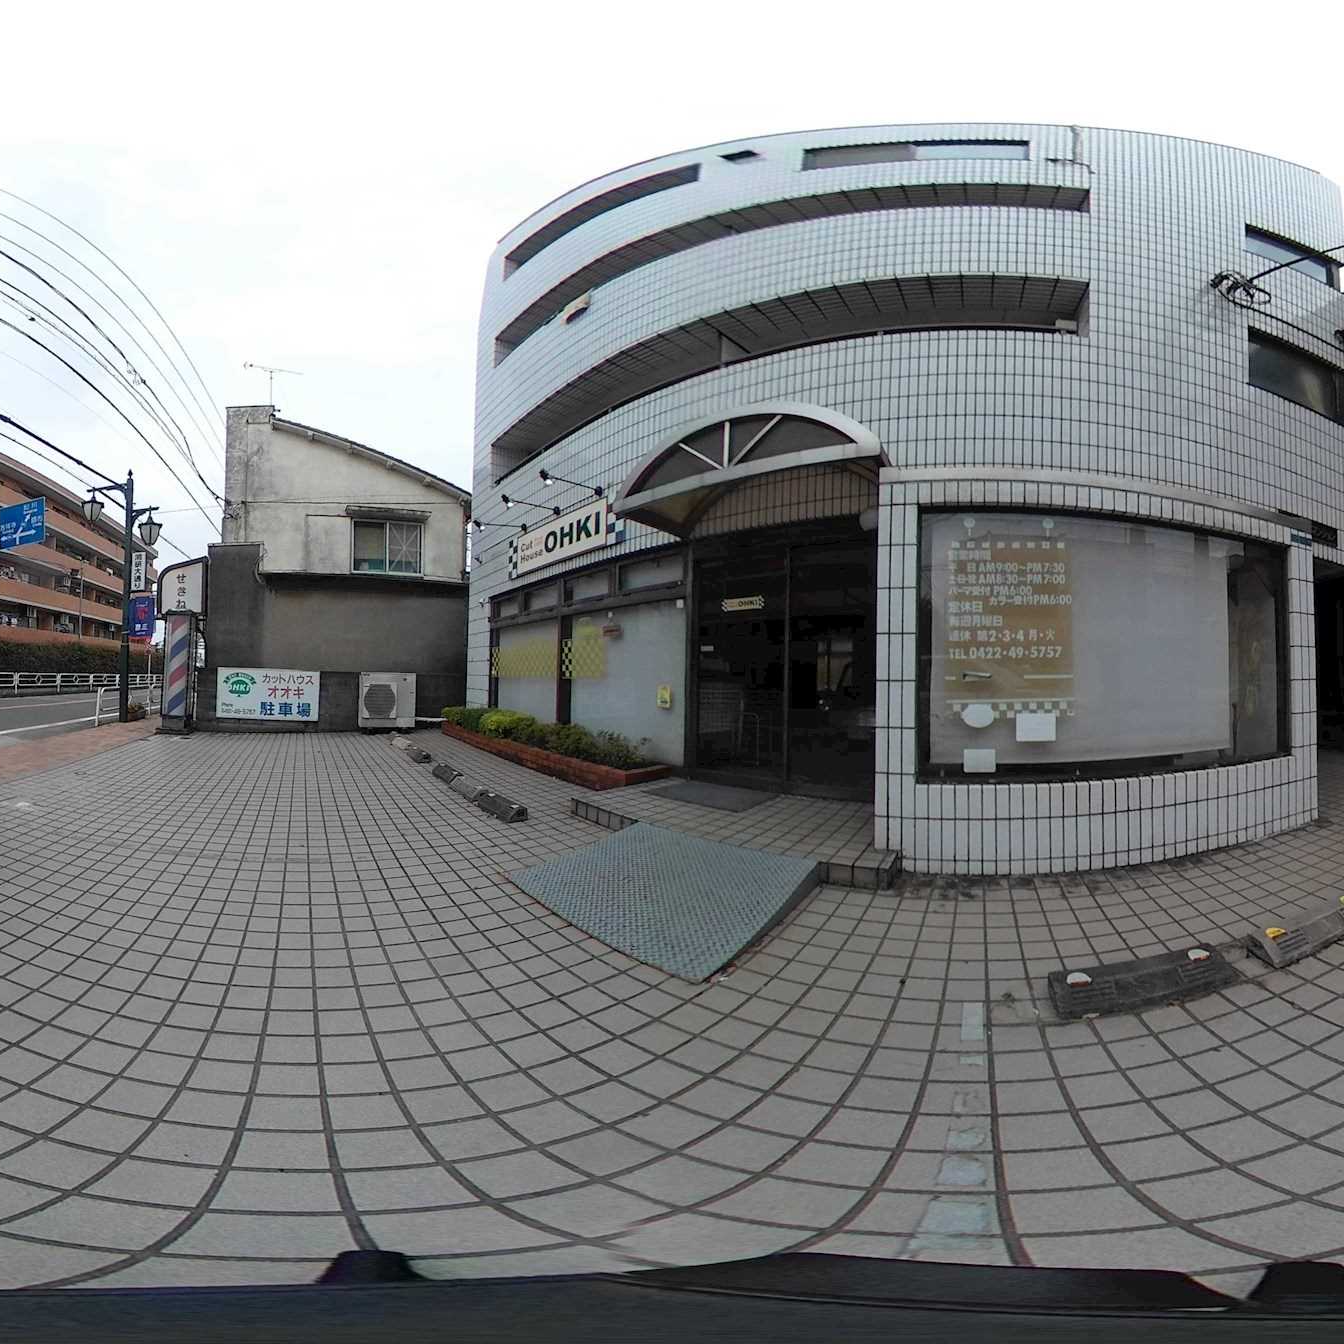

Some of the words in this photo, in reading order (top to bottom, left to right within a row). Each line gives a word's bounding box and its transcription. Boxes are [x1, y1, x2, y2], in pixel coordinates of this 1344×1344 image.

[544, 511, 601, 554] OHKI
[520, 540, 534, 553] Cut
[520, 549, 544, 564] House
[993, 586, 1033, 595] PM6:00
[948, 601, 983, 613] 定休日
[949, 648, 967, 660] TEL
[261, 673, 314, 686] カットハウス
[267, 685, 305, 700] オオキ
[259, 702, 312, 719] 駐車場
